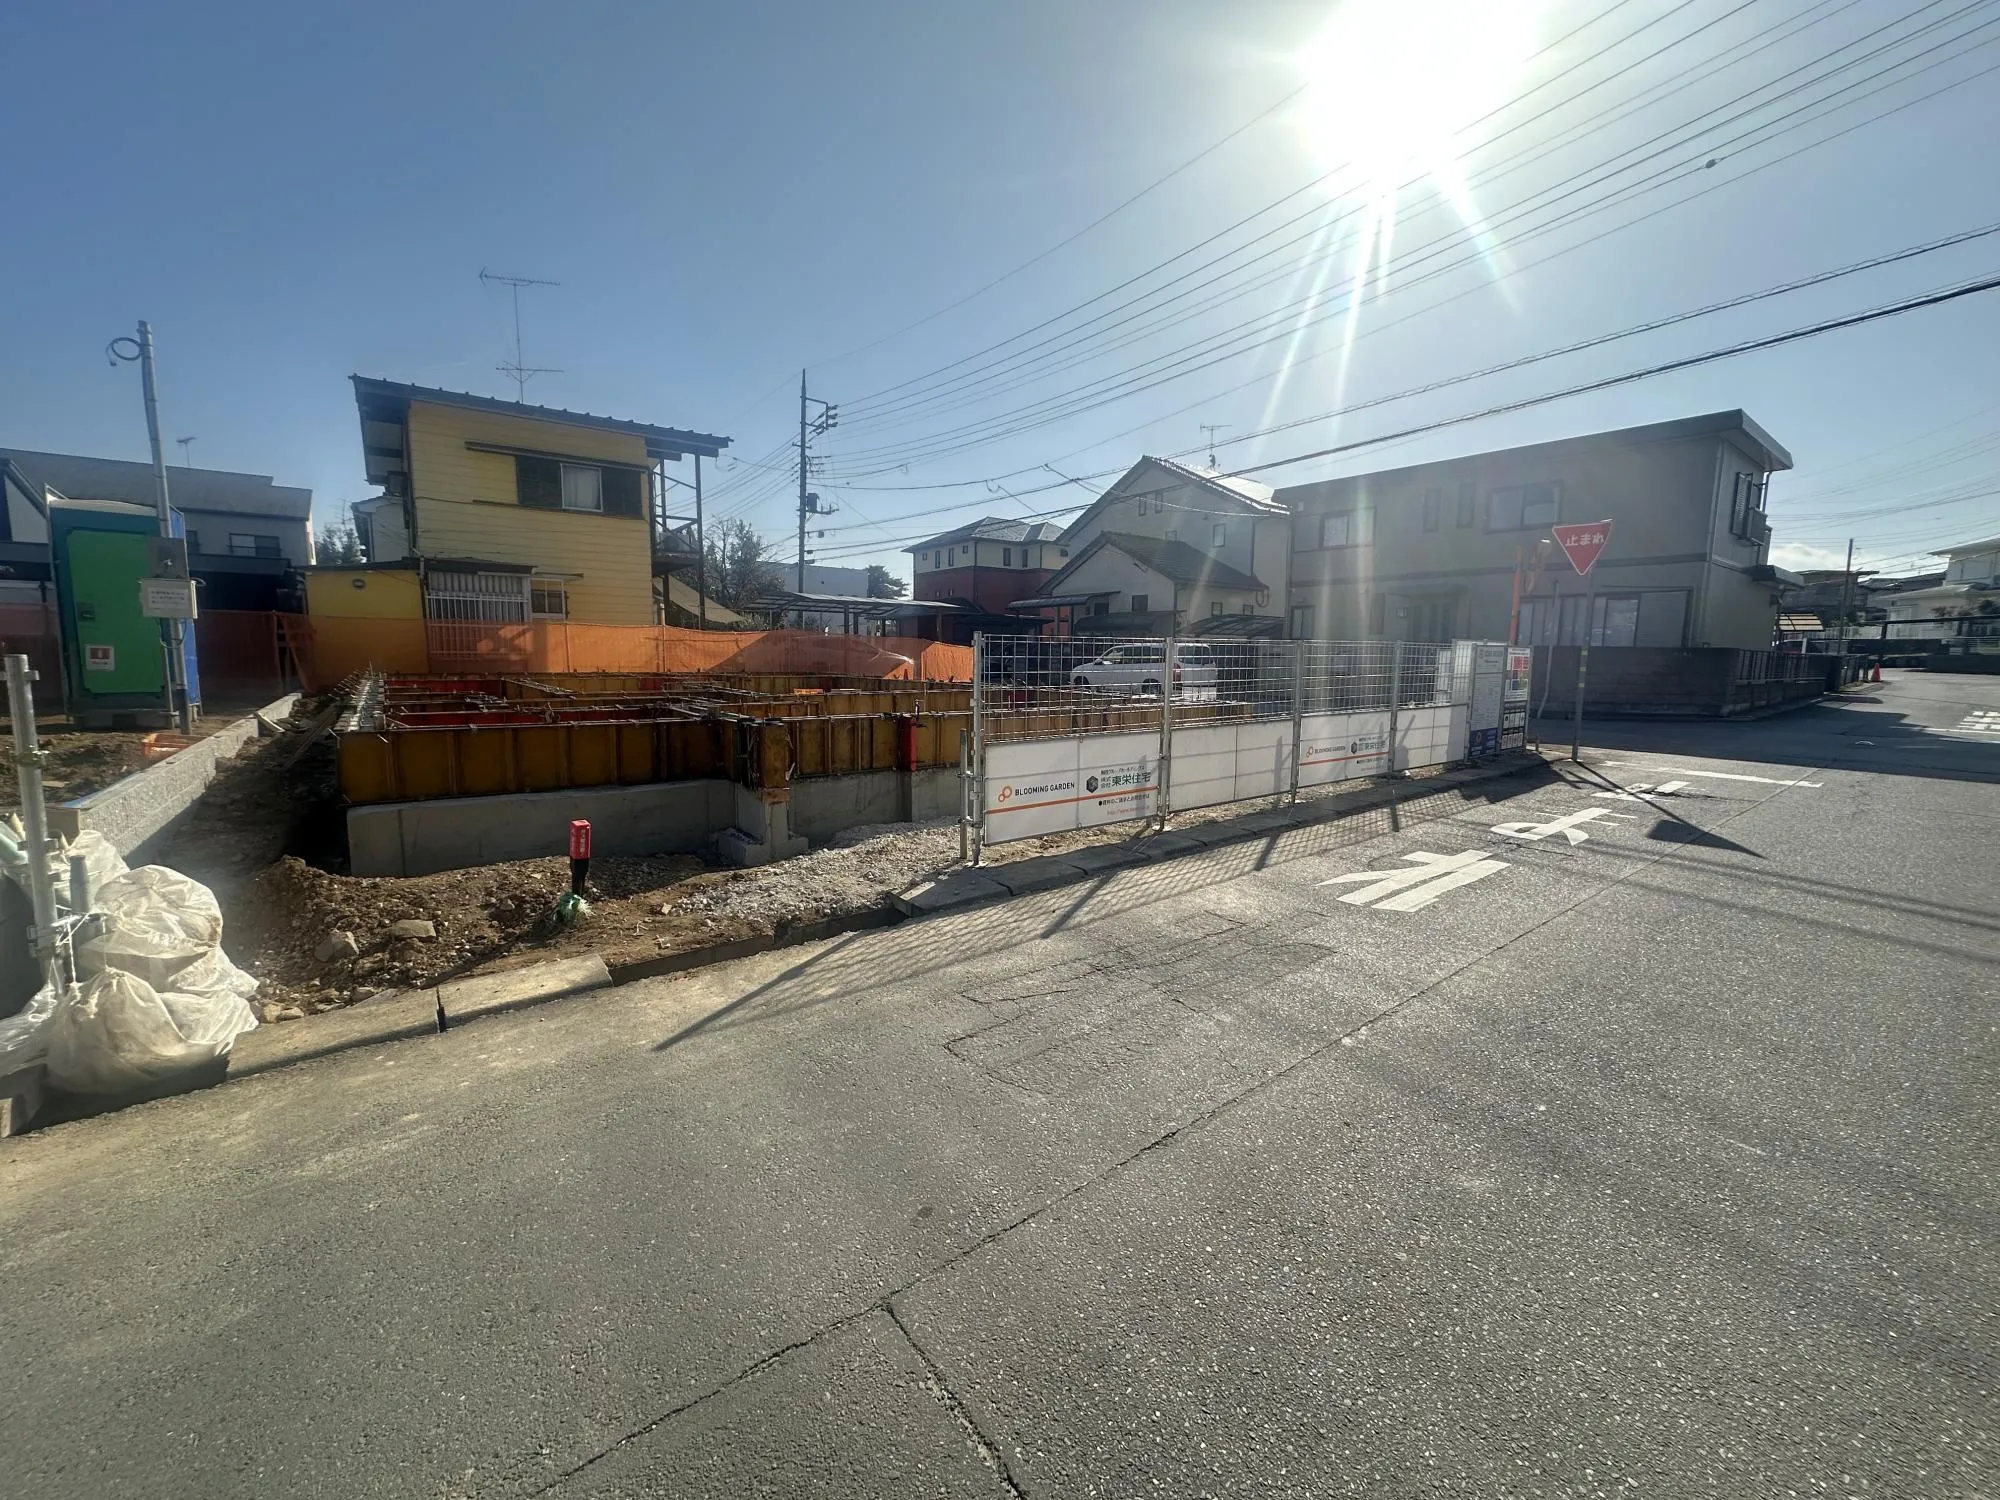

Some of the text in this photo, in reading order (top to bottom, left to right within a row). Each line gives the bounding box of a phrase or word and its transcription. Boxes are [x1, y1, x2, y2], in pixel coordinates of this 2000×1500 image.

[1565, 532, 1605, 546] 止まれ
[1111, 771, 1151, 787] 東栄住宅
[1014, 782, 1075, 796] BLOOMING GARDEN
